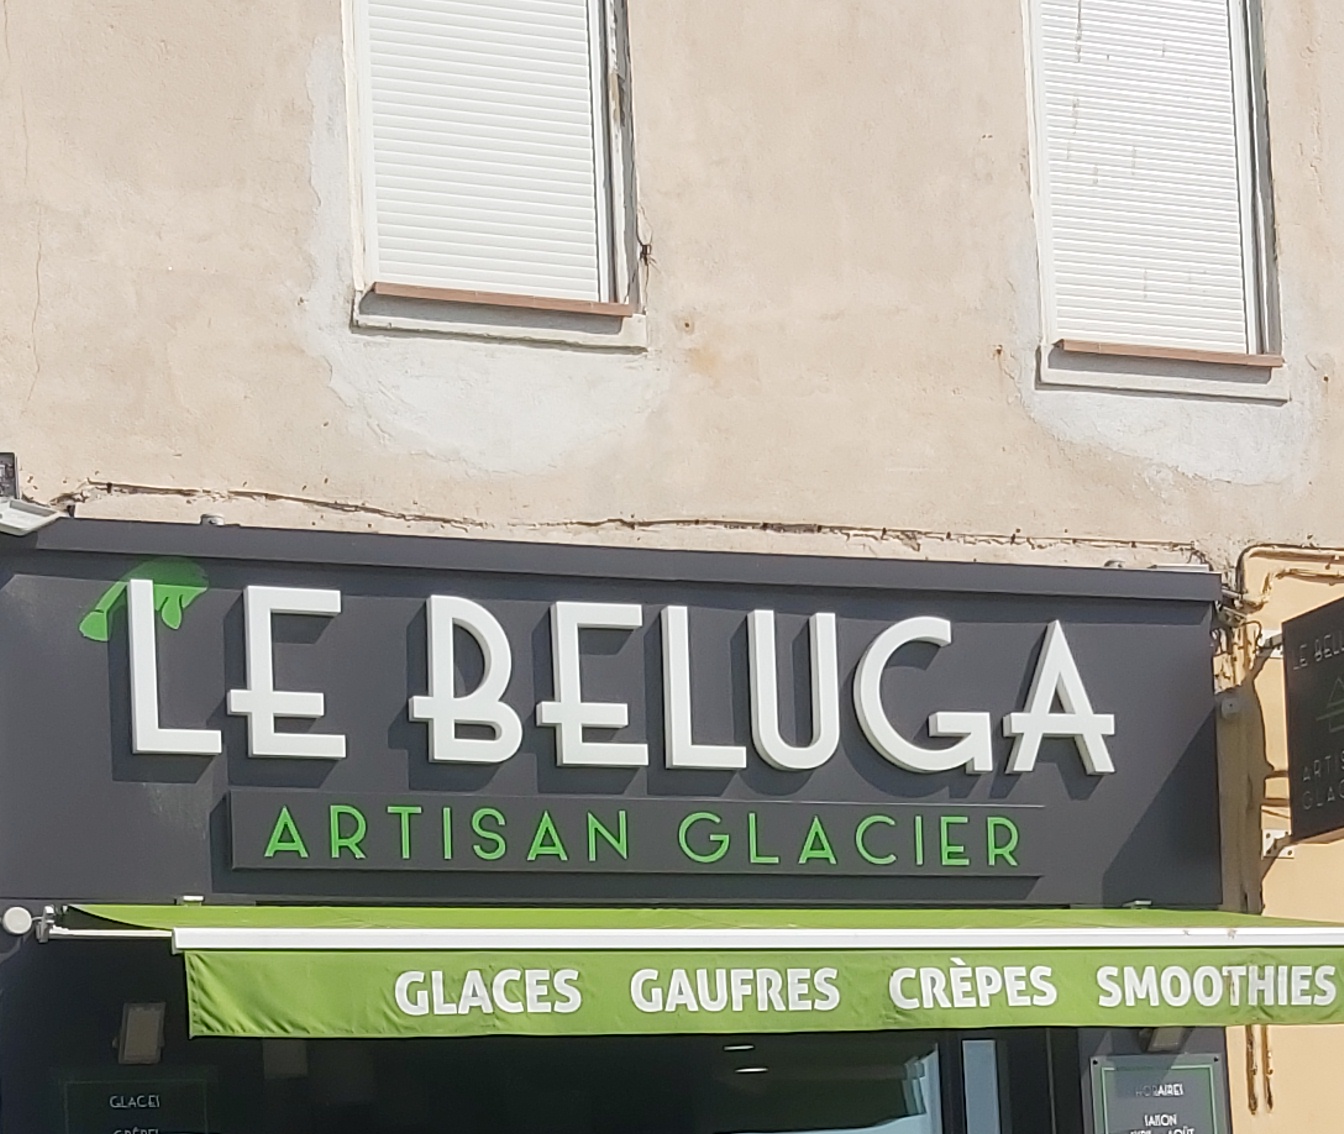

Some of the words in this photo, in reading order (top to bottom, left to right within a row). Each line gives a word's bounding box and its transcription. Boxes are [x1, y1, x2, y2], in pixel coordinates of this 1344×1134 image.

[127, 578, 347, 759] LE
[408, 594, 1116, 776] BELUGA
[1292, 644, 1309, 671] LE
[263, 805, 629, 861] ARTISAN
[677, 812, 1020, 867] GLACIER
[394, 967, 583, 1017] GLACES
[629, 966, 842, 1013] GAUFRES
[888, 957, 1058, 1010] CRÈPES
[1095, 963, 1338, 1008] SMOOTHIES
[109, 1095, 160, 1108] GLACES
